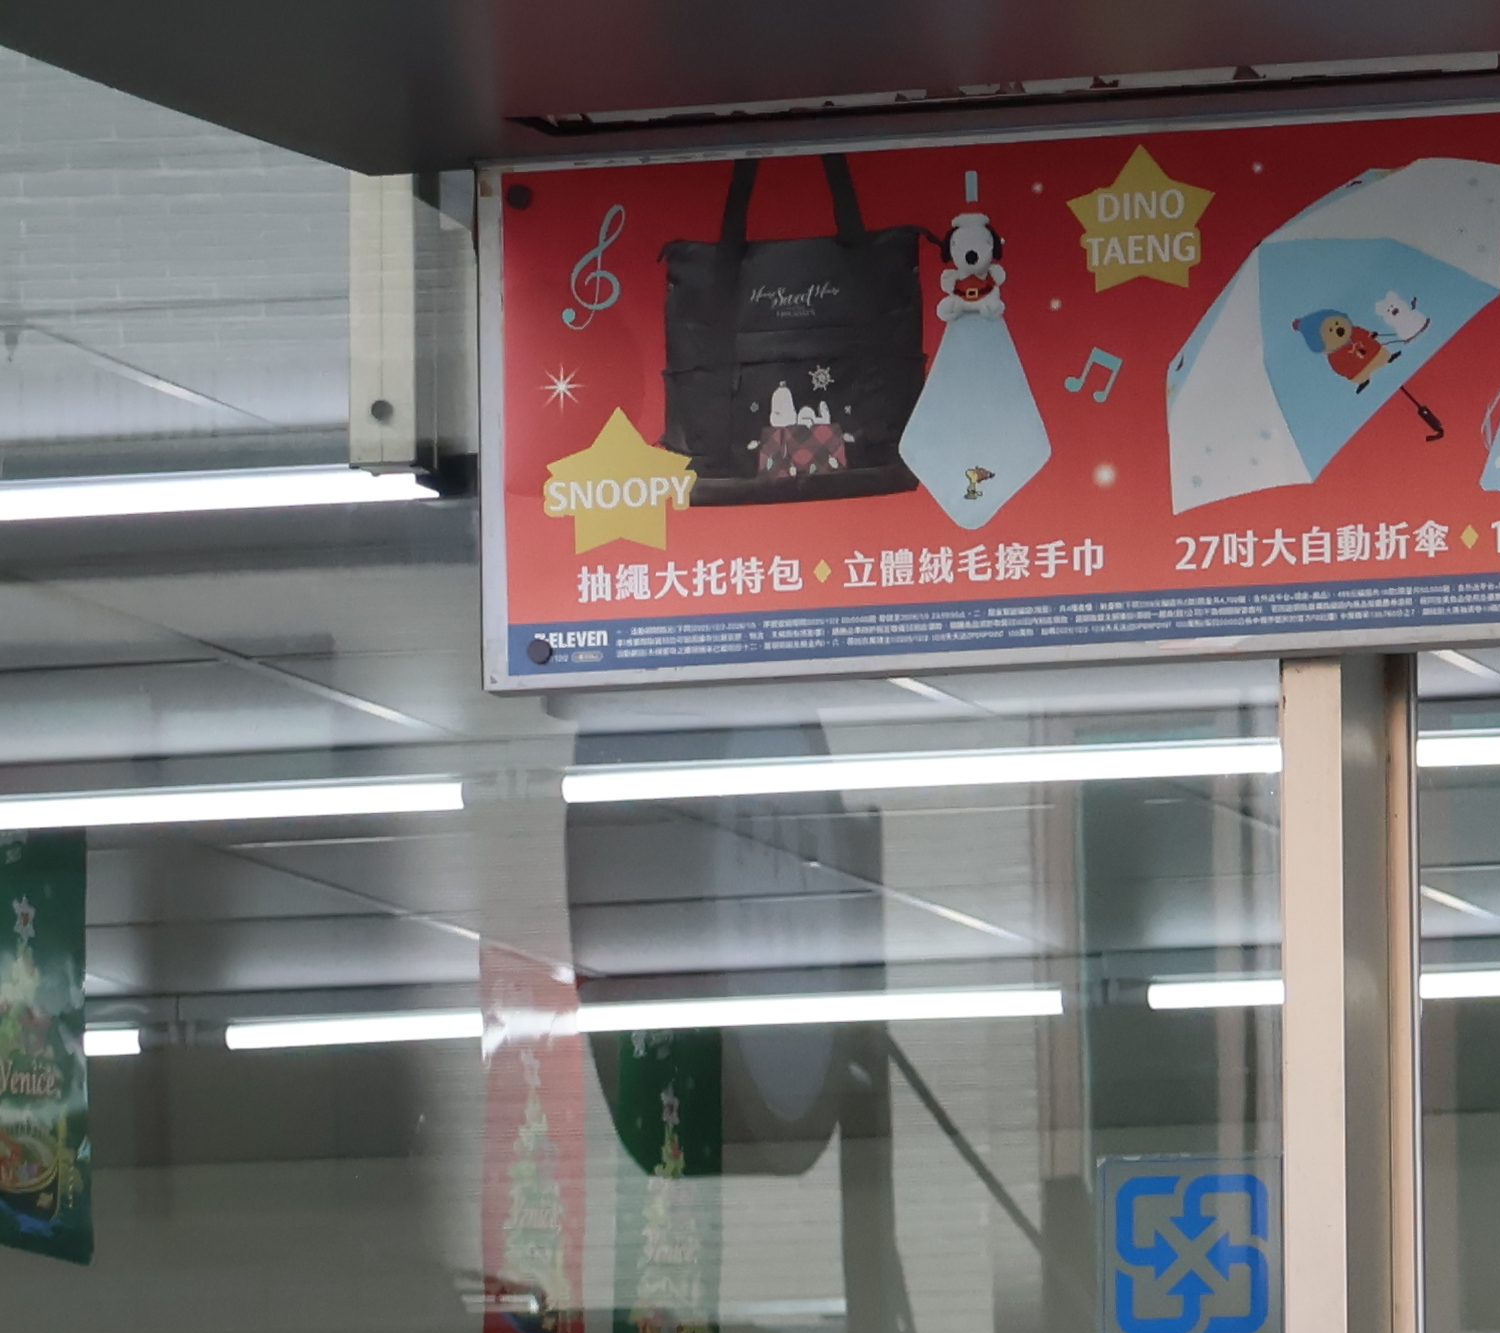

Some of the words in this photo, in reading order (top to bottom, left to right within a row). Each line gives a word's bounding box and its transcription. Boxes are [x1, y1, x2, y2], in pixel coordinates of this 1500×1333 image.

[1094, 188, 1186, 225] DINO
[1086, 232, 1197, 270] TAENG
[545, 476, 692, 515] SNOOPY
[1173, 518, 1452, 571] 27吋大自動折傘
[575, 550, 803, 605] 抽繩大托特包
[840, 540, 1107, 591] 立體絨毛擦手巾
